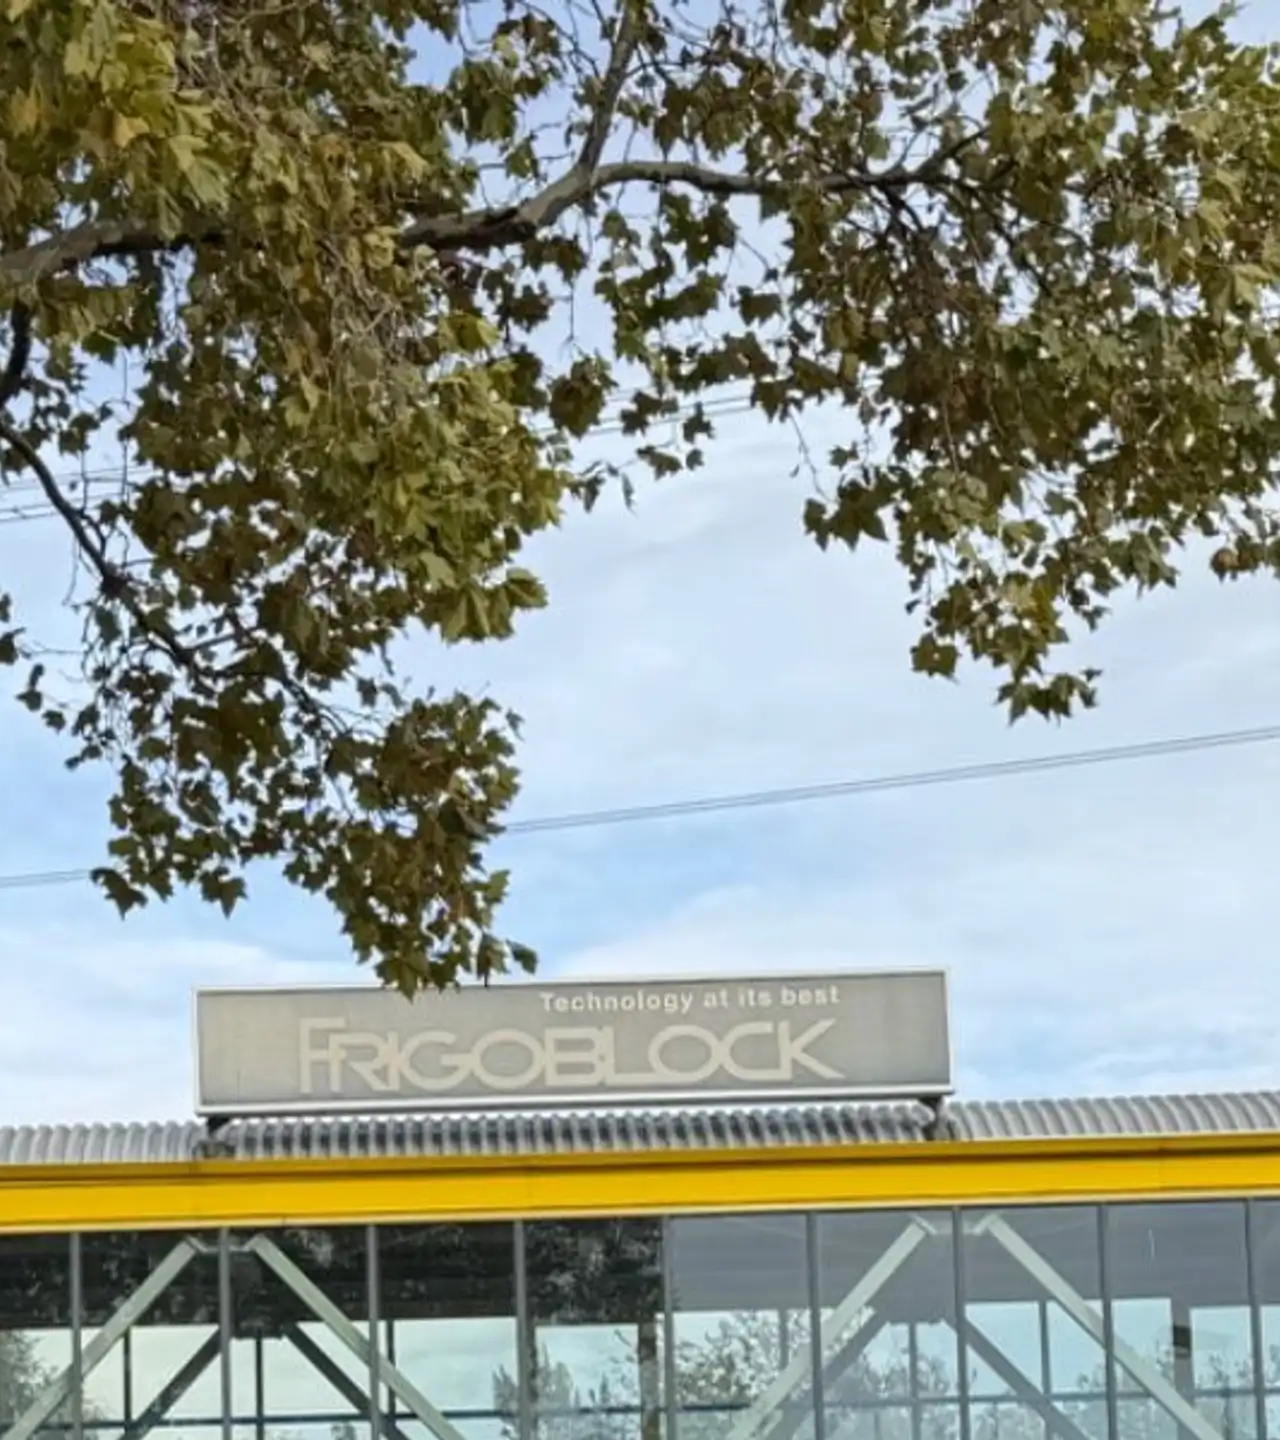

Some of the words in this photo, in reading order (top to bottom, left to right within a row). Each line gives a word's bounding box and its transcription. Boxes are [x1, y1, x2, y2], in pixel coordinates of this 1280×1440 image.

[539, 988, 694, 1015] Technology
[703, 989, 728, 1008] at
[739, 987, 773, 1007] its
[781, 984, 840, 1006] best
[298, 1017, 847, 1094] FRIGOBLOCK
